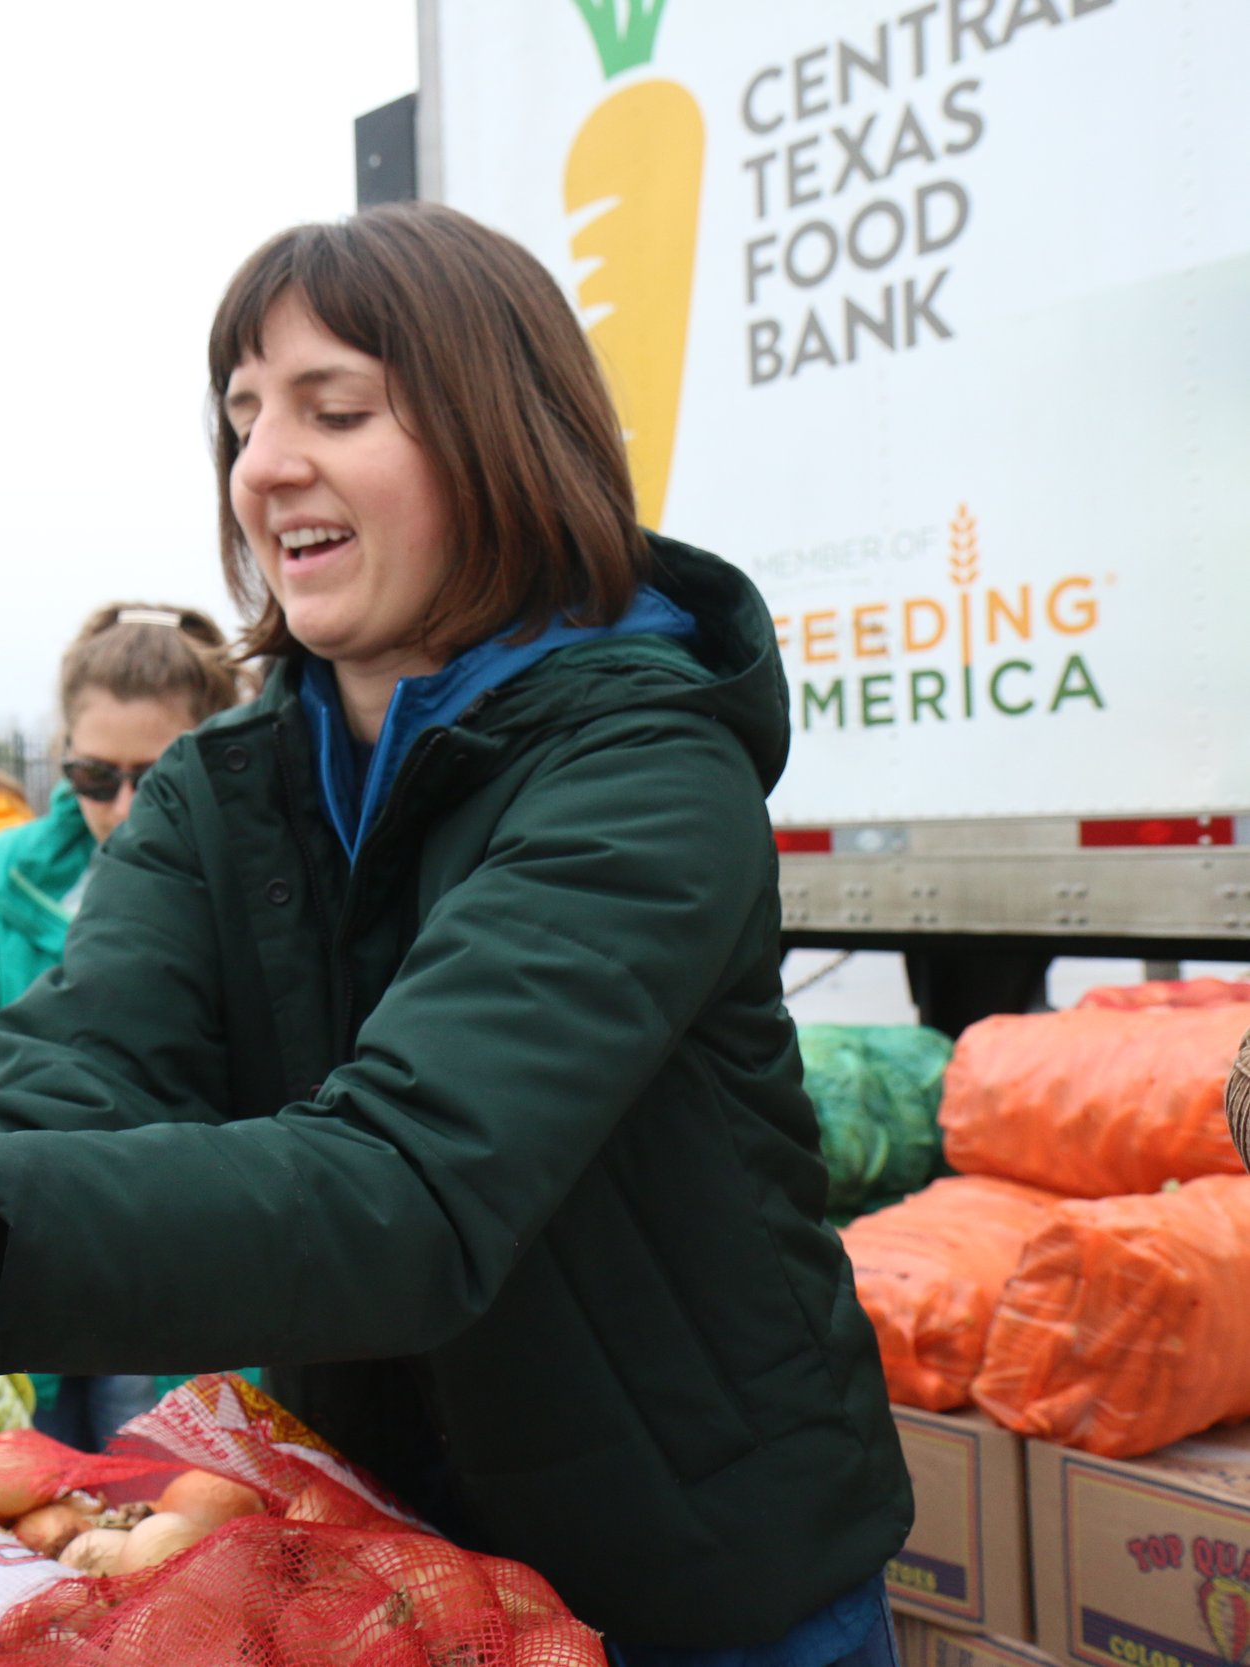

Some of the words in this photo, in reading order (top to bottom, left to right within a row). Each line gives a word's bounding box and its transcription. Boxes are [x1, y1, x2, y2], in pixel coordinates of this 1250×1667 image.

[741, 79, 985, 220] TEXAS
[744, 179, 970, 305] FOOD
[747, 269, 955, 387] BANK
[752, 534, 882, 580] MEMBER
[890, 525, 938, 562] OF
[801, 652, 1106, 731] MERICA
[1126, 1534, 1184, 1574] TOP
